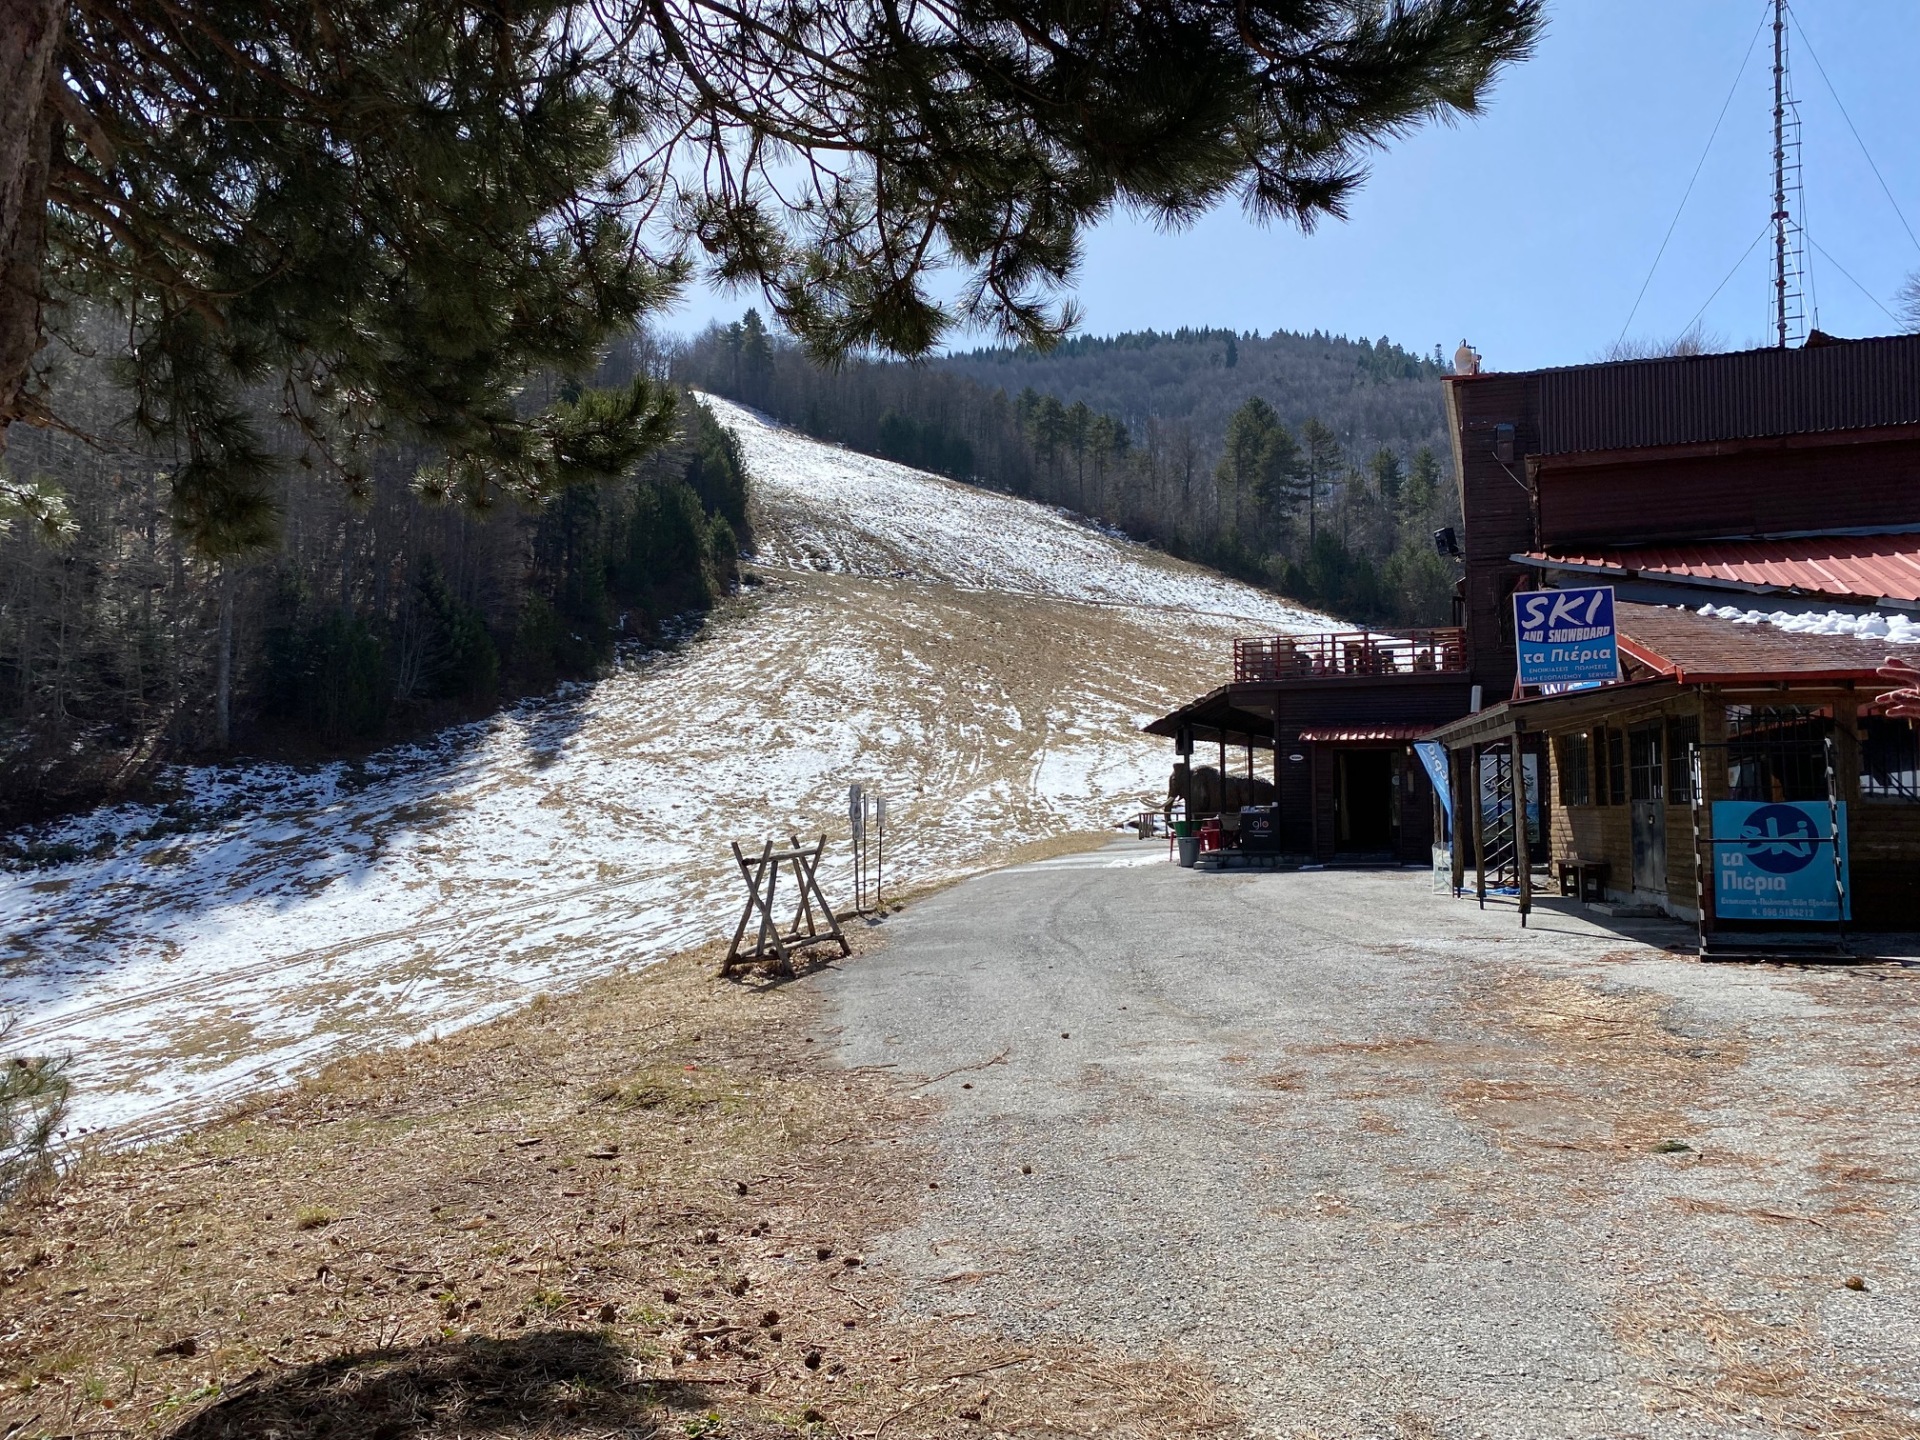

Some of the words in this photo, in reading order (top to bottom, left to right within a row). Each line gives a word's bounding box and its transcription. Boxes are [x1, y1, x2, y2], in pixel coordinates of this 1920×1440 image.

[1521, 591, 1604, 629] SKI
[1522, 630, 1544, 642] AND
[1547, 626, 1611, 643] SNOWBOARD
[1523, 652, 1545, 664] τα
[1551, 645, 1611, 664] Πιέρια
[1252, 817, 1269, 830] glo
[1740, 816, 1812, 857] ski
[1721, 852, 1744, 866] τα
[1722, 870, 1786, 895] Πιέρια
